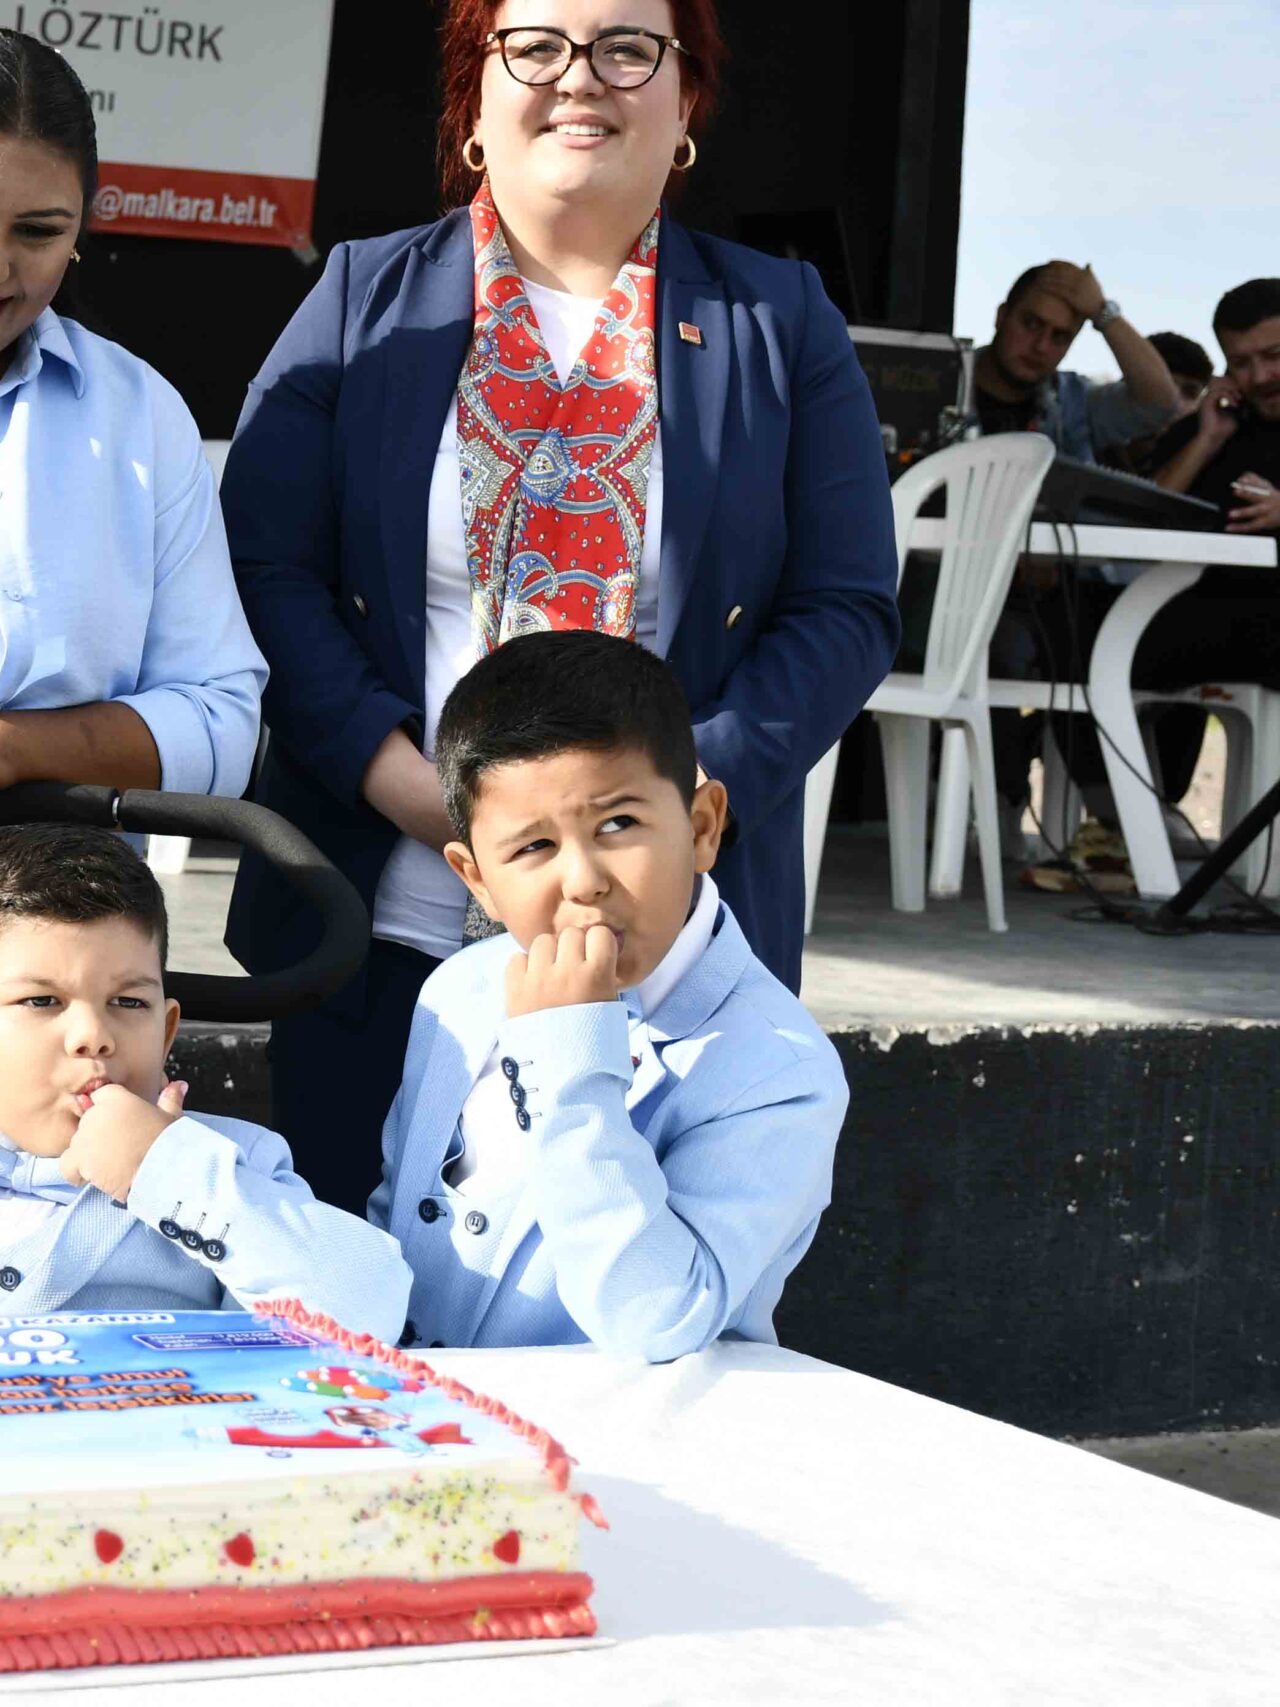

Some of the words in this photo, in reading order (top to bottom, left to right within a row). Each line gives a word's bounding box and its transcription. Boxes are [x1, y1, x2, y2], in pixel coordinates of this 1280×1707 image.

[39, 0, 224, 62] ÖZTÜRK
[99, 1368, 189, 1383] umut
[52, 1381, 195, 1398] herkese
